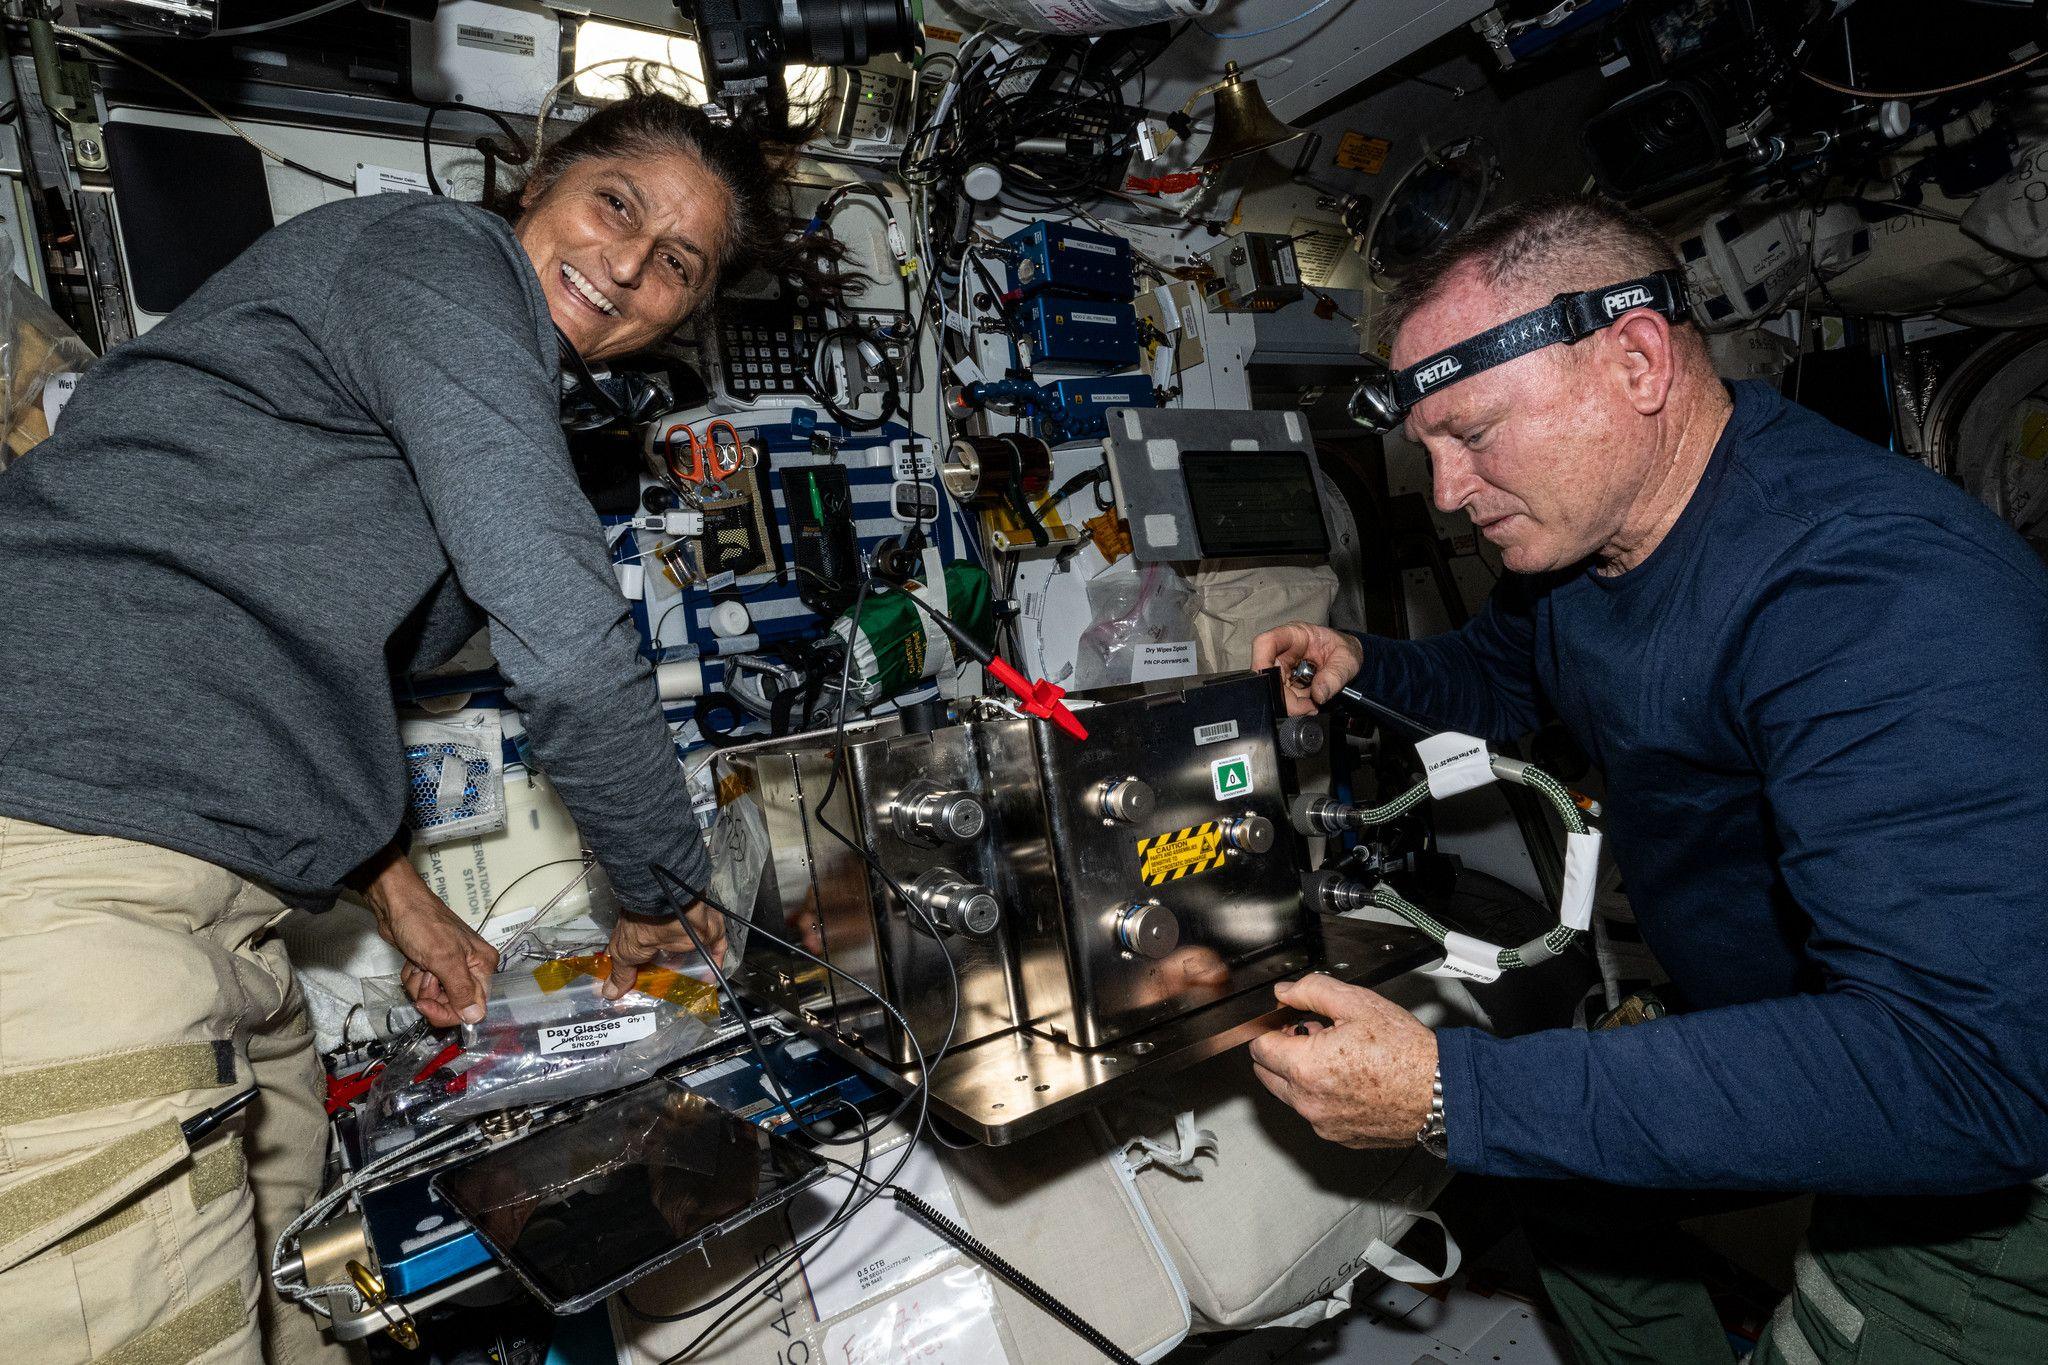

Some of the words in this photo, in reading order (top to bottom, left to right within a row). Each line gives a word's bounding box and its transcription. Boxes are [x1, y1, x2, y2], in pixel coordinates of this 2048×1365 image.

[1604, 288, 1654, 319] PETZL
[1498, 319, 1559, 348] TIKKA
[1415, 357, 1462, 393] PETZL
[58, 379, 73, 389] Wet
[1145, 646, 1155, 654] Dry
[1156, 645, 1173, 654] Wipes
[1447, 755, 1459, 763] Hose
[1469, 747, 1480, 755] UPA
[1230, 774, 1236, 784] 0
[1150, 852, 1164, 861] PARTS
[1173, 844, 1197, 855] ASSEMBLIES
[1156, 840, 1188, 854] CAUTION
[1152, 860, 1184, 873] ELECTROSTATIC
[1184, 854, 1207, 865] DISCHARGE
[463, 868, 480, 915] STATION
[547, 1029, 571, 1038] Day
[573, 1020, 621, 1035] Glasses
[571, 1041, 586, 1049] S/N
[857, 1267, 869, 1278] 0.5
[869, 1259, 885, 1272] CTB
